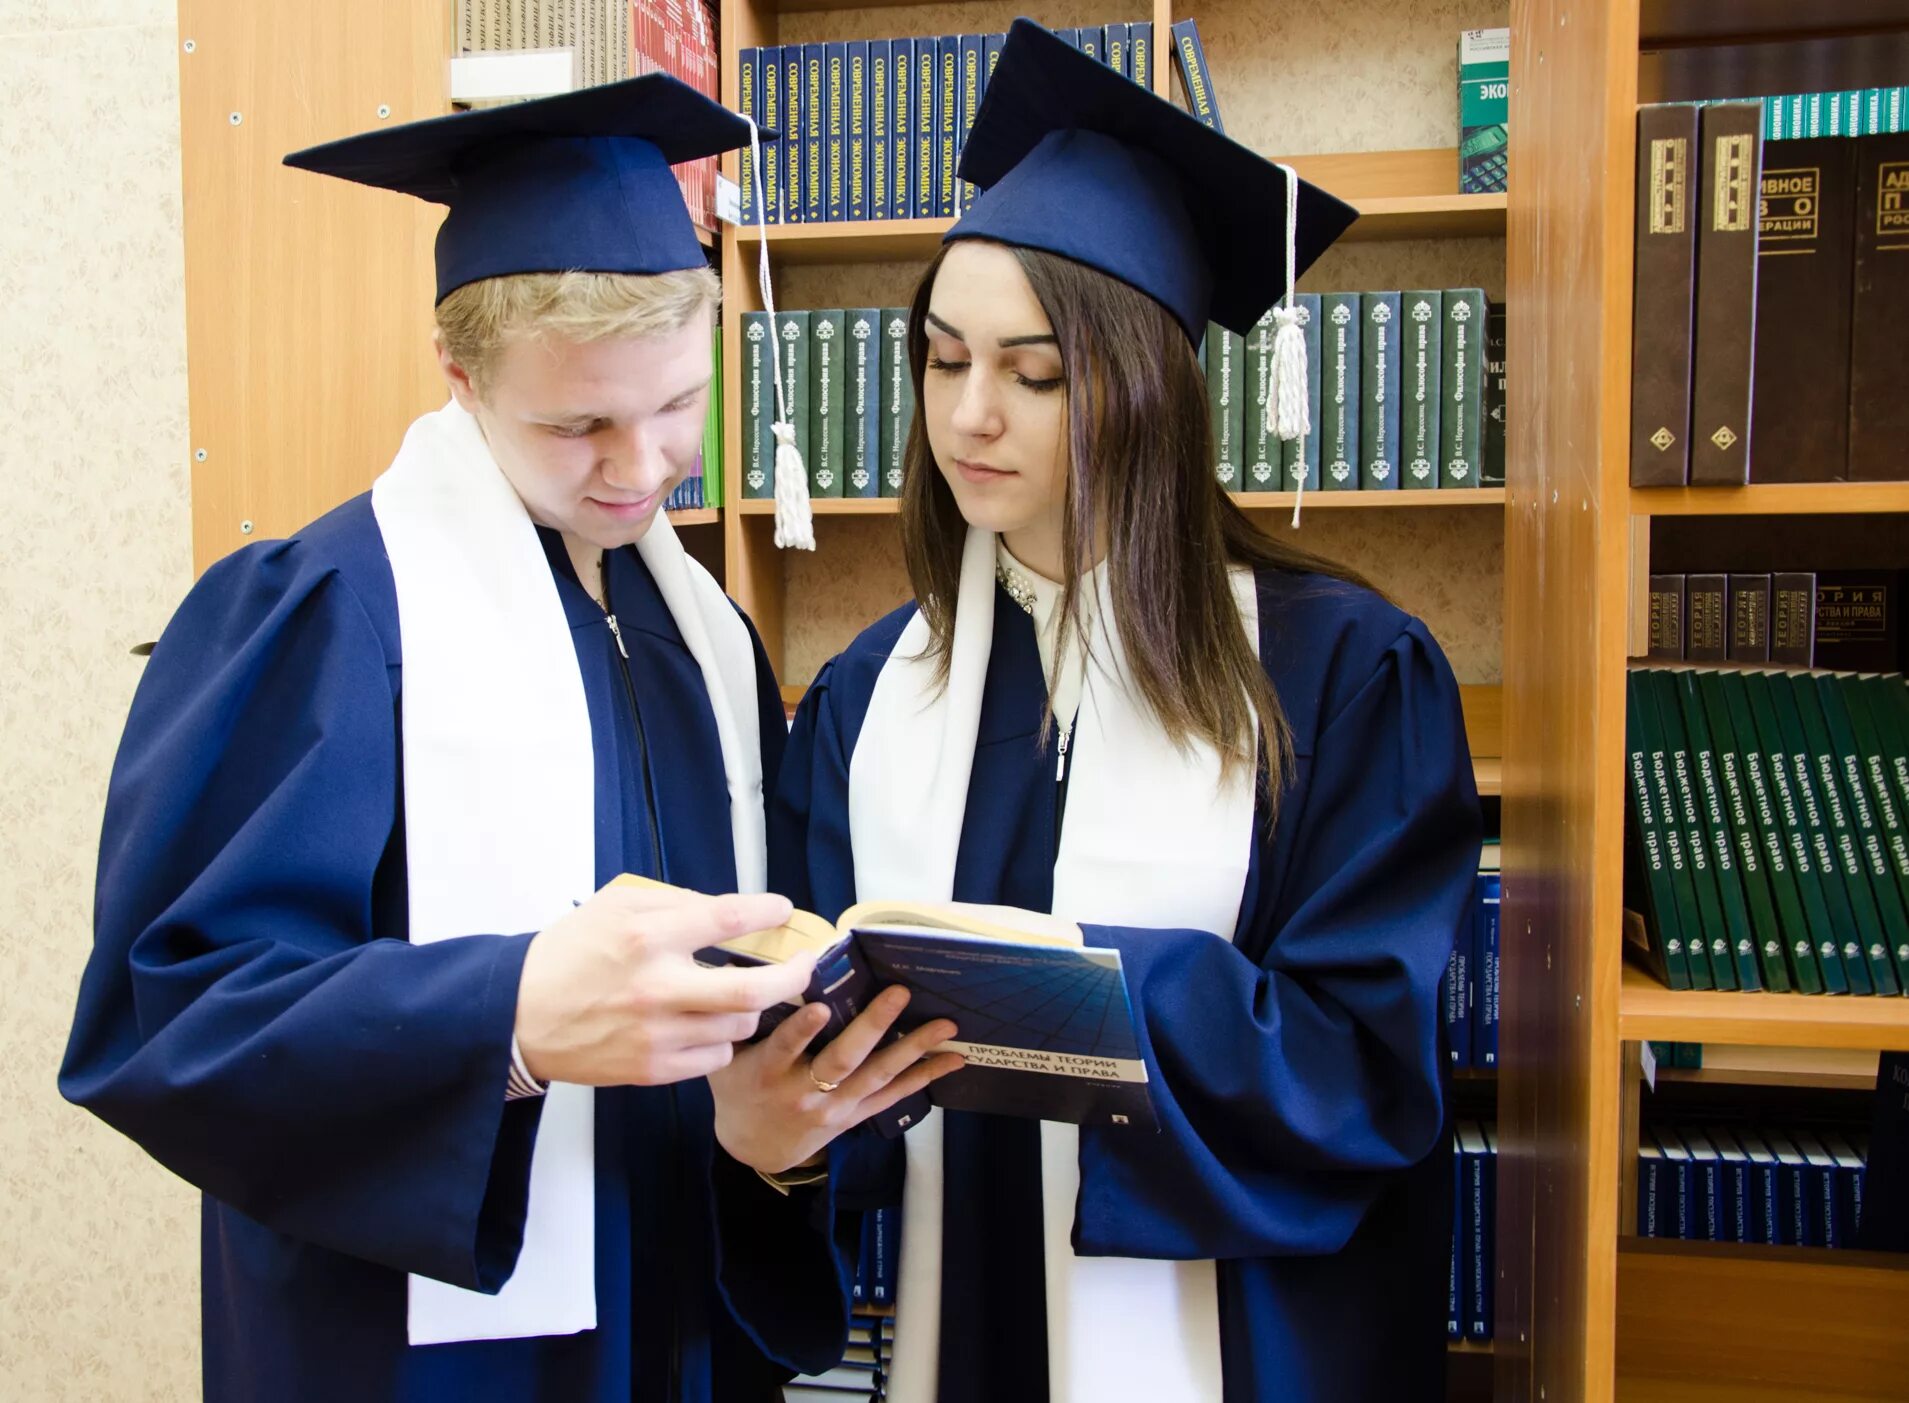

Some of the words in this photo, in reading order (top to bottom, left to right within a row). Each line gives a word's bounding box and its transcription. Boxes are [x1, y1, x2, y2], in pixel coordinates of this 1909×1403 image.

[788, 63, 799, 139] СОВРЕМЕННАЯ
[809, 60, 819, 136] СОВРЕМЕННАЯ
[830, 58, 841, 135] СОВРЕМЕННАЯ
[852, 57, 862, 134] СОВРЕМЕННАЯ
[875, 58, 885, 136] СОВРЕМЕННАЯ
[896, 55, 907, 132] СОВРЕМЕННАЯ
[921, 54, 931, 132] СОВРЕМЕННАЯ
[943, 53, 954, 131] СОВРЕМЕННАЯ
[965, 50, 977, 128] СОВРЕМЕННАЯ
[1181, 36, 1210, 115] СОВРЕМЕННАЯ
[1480, 84, 1508, 100] ЭКО
[742, 146, 752, 209] ЭКОНОМИКА
[766, 146, 777, 211] ЭКОНОМИКА
[789, 144, 799, 210] ЭКОНОМИКА
[809, 142, 819, 206] ЭКОНОМИКА
[830, 140, 840, 204] ЭКОНОМИКА
[852, 139, 862, 204] ЭКОНОМИКА
[875, 140, 885, 206] ЭКОНОМИКА
[896, 138, 906, 203] ЭКОНОМИКА
[920, 136, 930, 203] ЭКОНОМИКА
[942, 136, 953, 202] ЭКОНОМИКА
[753, 345, 761, 367] права
[788, 344, 796, 366] права
[822, 343, 830, 365] права
[894, 342, 902, 364] права
[1223, 331, 1231, 355] права
[1338, 328, 1346, 351] права
[1378, 327, 1386, 350] права
[1419, 325, 1427, 349] права
[1458, 325, 1466, 349] права
[751, 370, 760, 415] Философия
[786, 369, 796, 414] Философия
[820, 368, 830, 414] Философия
[856, 368, 866, 414] Философия
[892, 367, 901, 413] Философия
[1220, 357, 1231, 405] Философия
[1258, 357, 1269, 405] Философия
[1336, 354, 1346, 403] Философия
[1376, 353, 1386, 402] Философия
[1416, 352, 1427, 400] Философия
[1454, 352, 1465, 401] Философия
[1376, 443, 1384, 457] В.С.
[1416, 442, 1424, 456] В.С.
[1454, 443, 1462, 456] В.С.
[1652, 592, 1660, 648] ТЕОРИЯ
[1694, 592, 1702, 648] ТЕОРИЯ
[1778, 591, 1787, 647] ТЕОРИЯ
[1852, 606, 1882, 617] ПРАВА
[1632, 751, 1652, 823] Бюджетное
[1647, 831, 1660, 870] право
[1652, 751, 1674, 823] Бюджетное
[1667, 831, 1682, 870] право
[1675, 751, 1696, 823] Бюджетное
[1690, 831, 1705, 870] право
[1699, 751, 1721, 823] Бюджетное
[1715, 831, 1730, 870] право
[1723, 753, 1746, 825] Бюджетное
[1740, 833, 1756, 872] право
[1747, 752, 1772, 825] Бюджетное
[1767, 832, 1784, 872] право
[1771, 753, 1798, 827] Бюджетное
[1792, 834, 1809, 872] право
[1794, 753, 1820, 827] Бюджетное
[1815, 834, 1832, 873] право
[1819, 755, 1845, 828] Бюджетное
[1840, 835, 1857, 874] право
[1844, 755, 1872, 829] Бюджетное
[1867, 835, 1884, 875] право
[1868, 756, 1898, 829] Бюджетное
[1894, 835, 1909, 876] право
[968, 1045, 1050, 1062] ПРОБЛЕМЫ
[1056, 1055, 1116, 1068] ТЕОРИИ
[1071, 1066, 1120, 1078] ПРАВА
